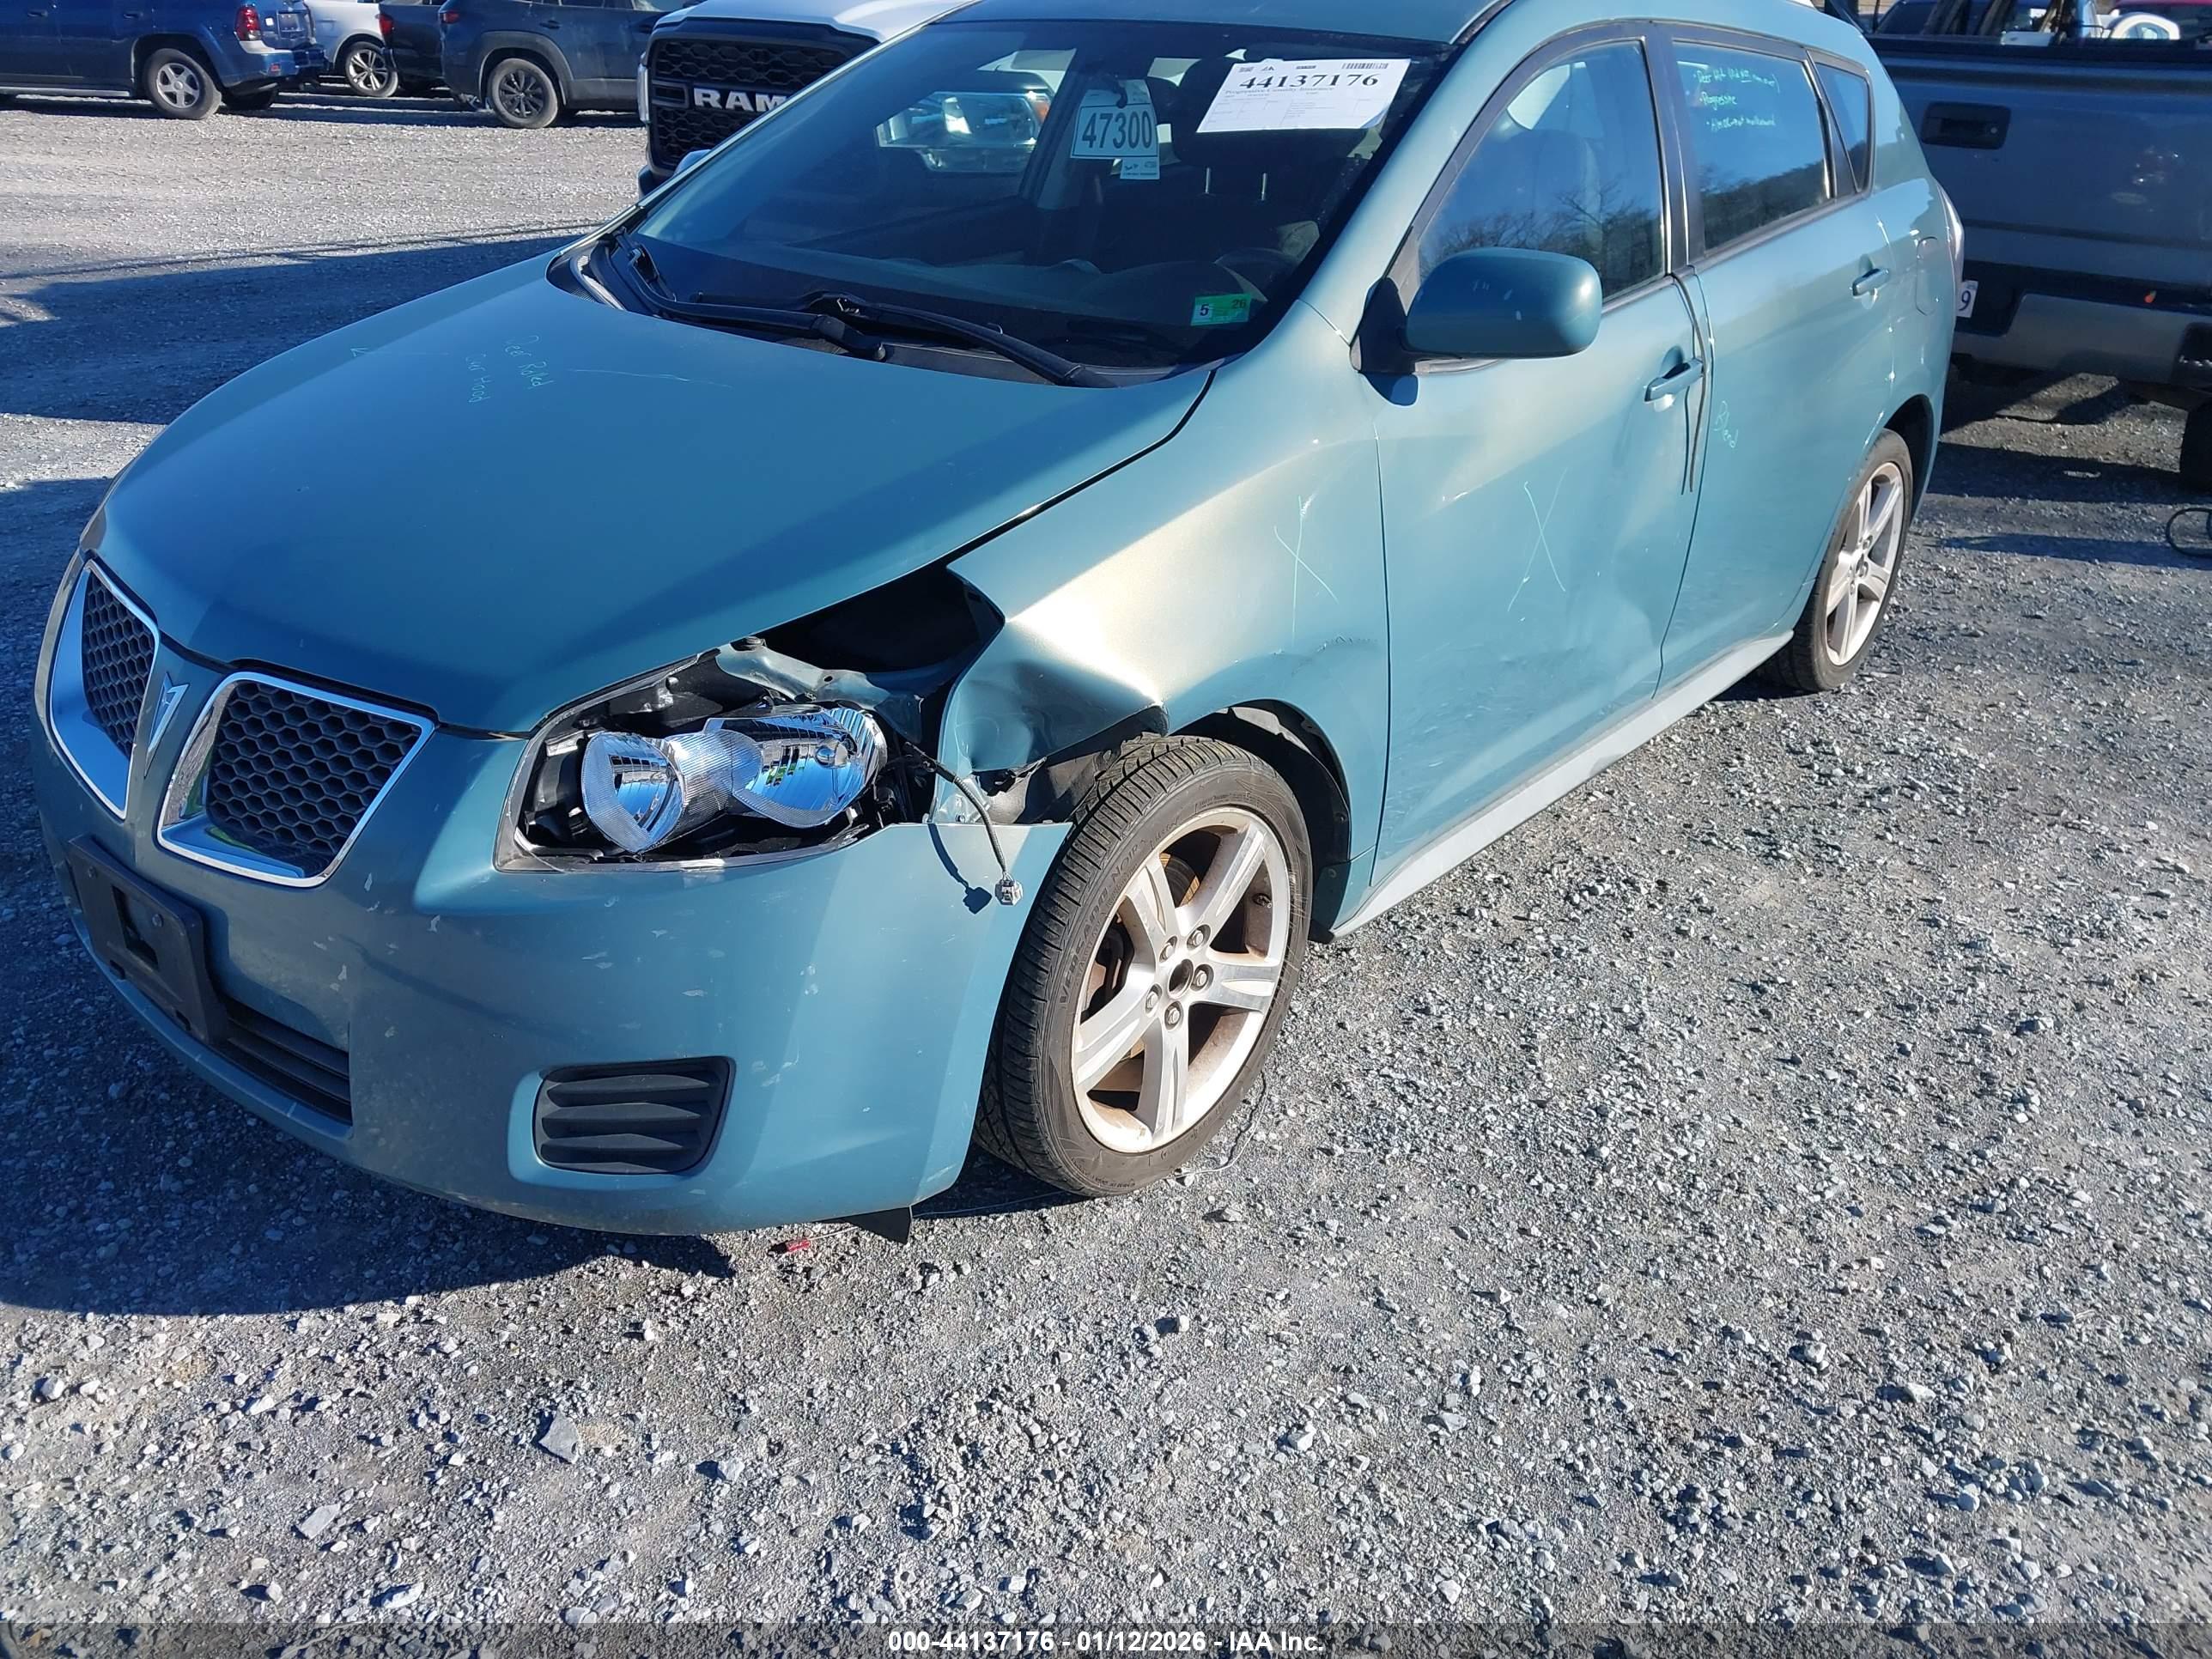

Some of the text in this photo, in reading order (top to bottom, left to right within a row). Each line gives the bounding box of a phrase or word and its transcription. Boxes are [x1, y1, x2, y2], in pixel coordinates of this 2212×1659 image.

[1239, 73, 1380, 89] 44137176
[693, 88, 789, 112] RAM
[1082, 110, 1152, 149] 47300
[1200, 298, 1247, 316] 5 26
[1958, 290, 1972, 311] 9
